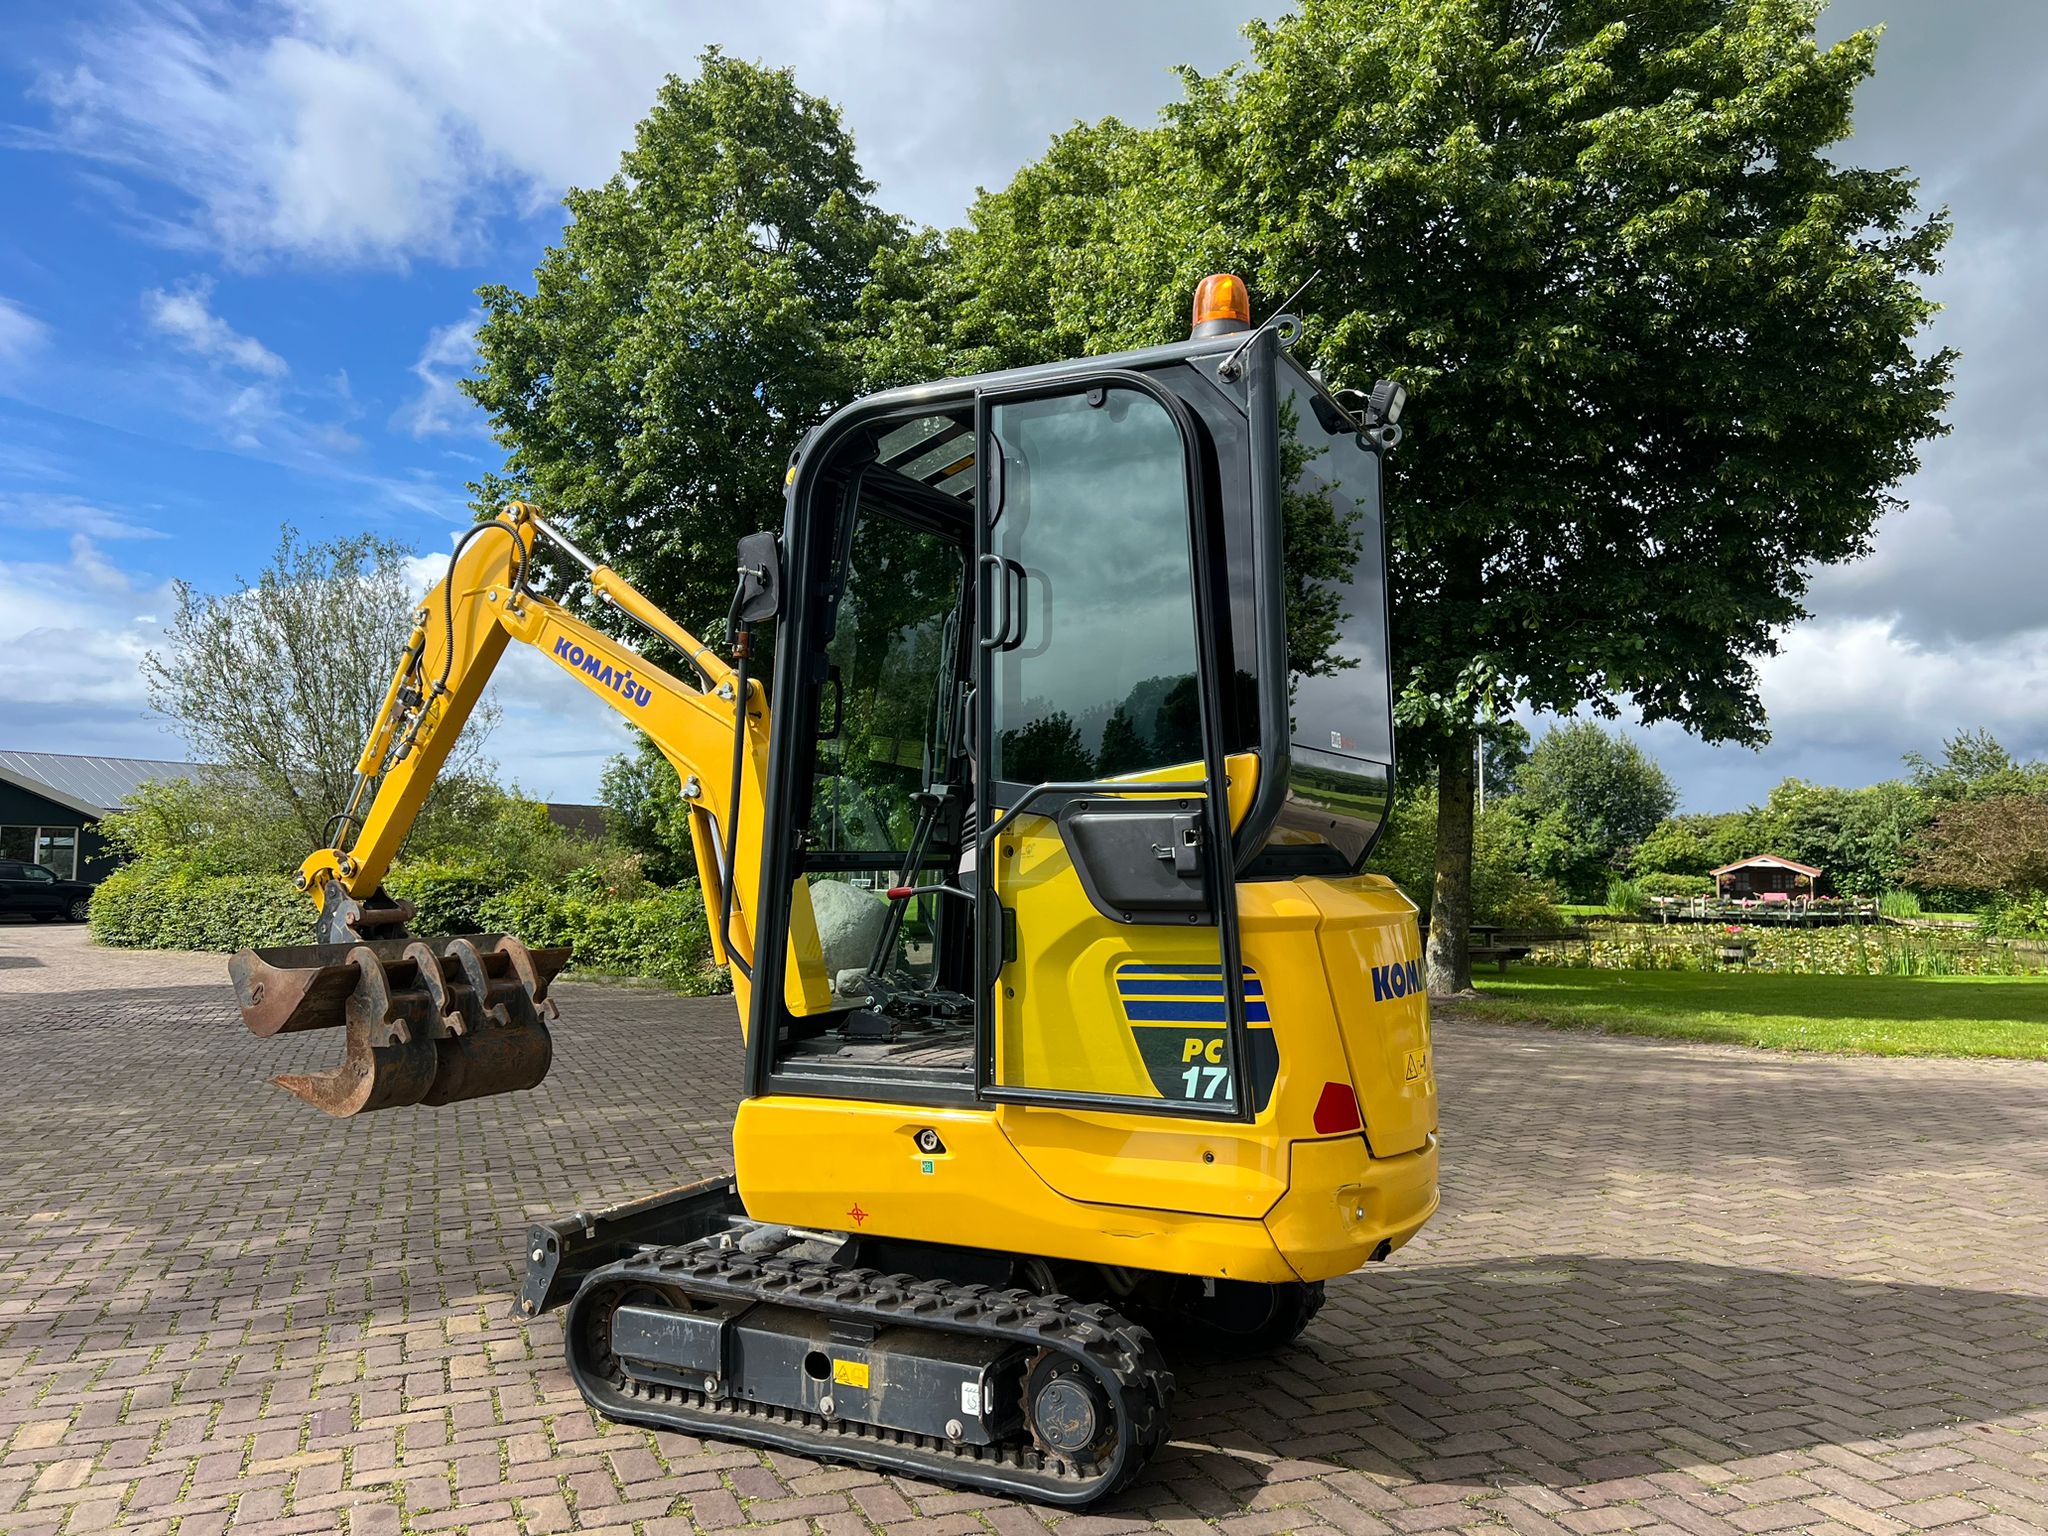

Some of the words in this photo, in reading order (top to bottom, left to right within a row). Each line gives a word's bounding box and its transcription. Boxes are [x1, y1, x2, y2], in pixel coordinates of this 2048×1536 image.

[553, 636, 652, 707] KOMATSU
[1371, 959, 1423, 1002] KOM
[1182, 1038, 1224, 1064] PC
[1182, 1066, 1233, 1100] 17
